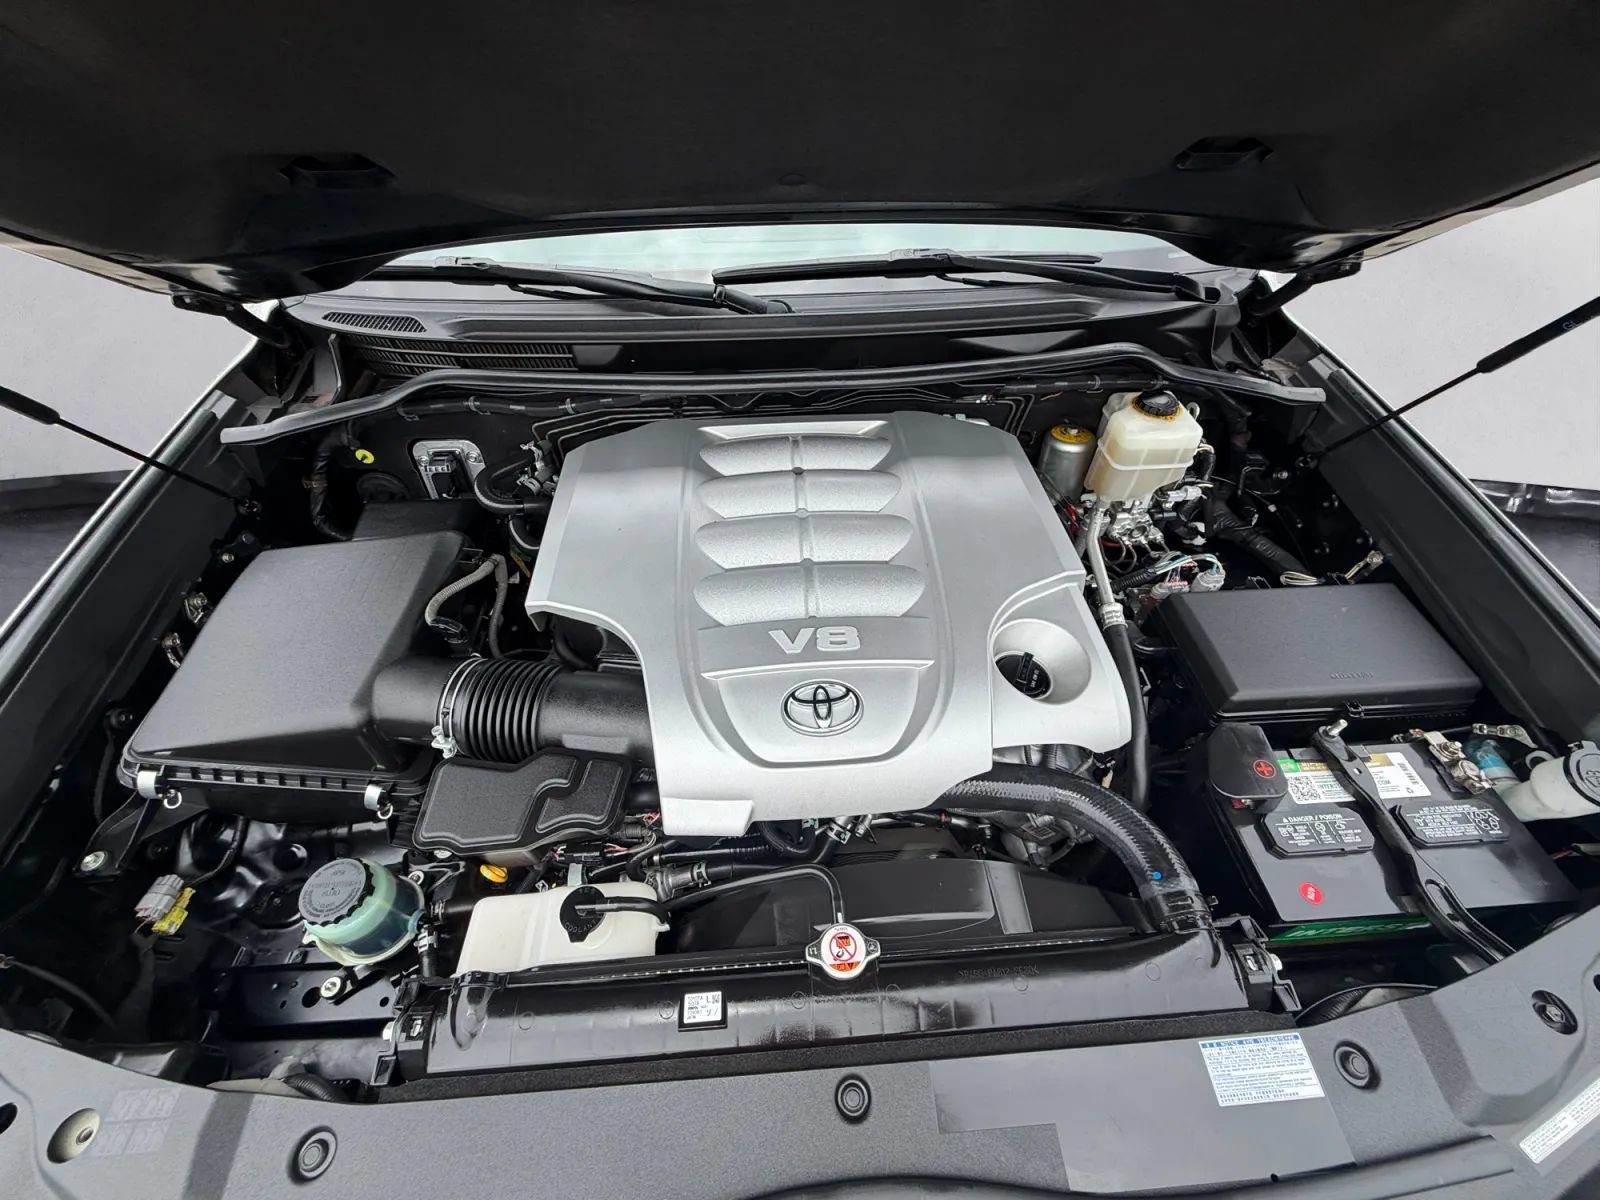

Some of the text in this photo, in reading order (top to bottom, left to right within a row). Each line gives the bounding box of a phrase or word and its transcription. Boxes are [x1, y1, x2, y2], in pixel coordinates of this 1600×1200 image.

[768, 626, 861, 654] V8
[1288, 815, 1314, 823] DANGER
[1319, 813, 1343, 821] POISON
[564, 920, 597, 933] COOLANT
